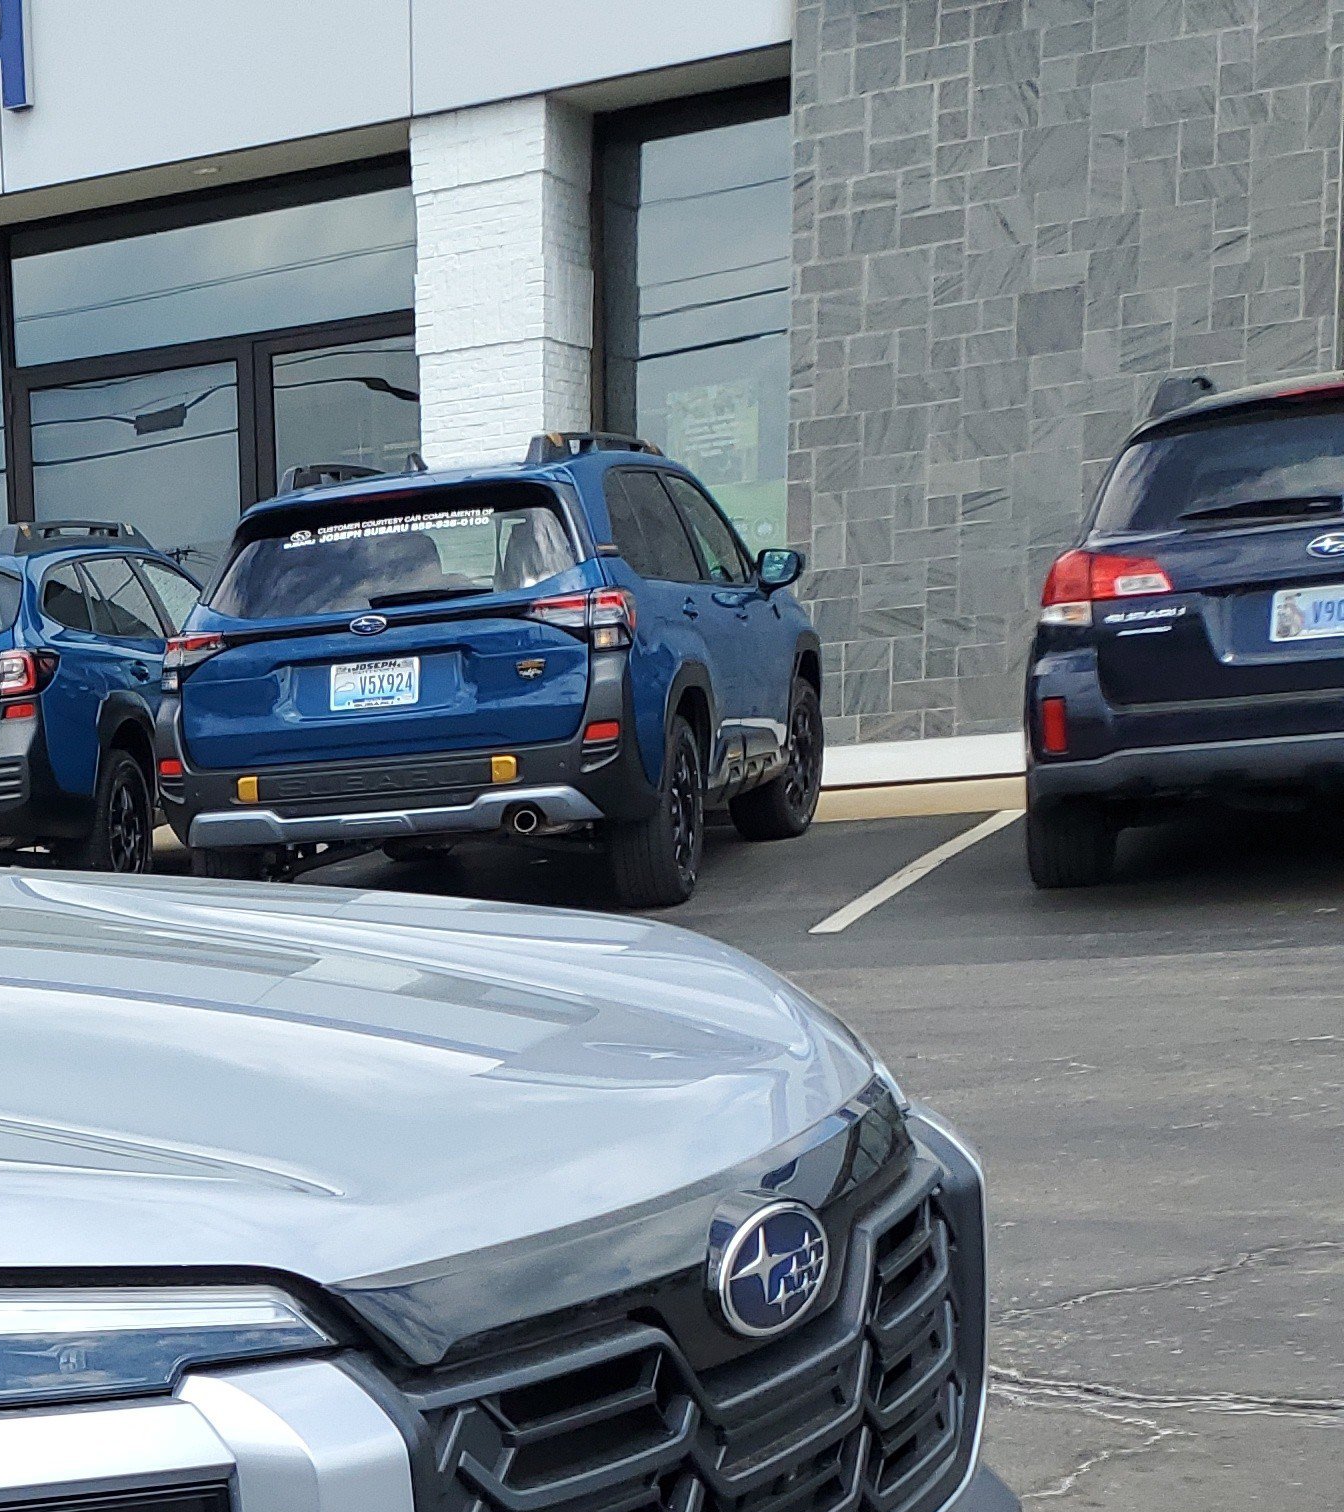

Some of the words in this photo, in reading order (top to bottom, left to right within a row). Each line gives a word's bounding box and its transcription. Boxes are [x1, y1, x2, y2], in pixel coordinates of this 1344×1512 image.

[318, 521, 361, 535] CUSTOMER
[362, 516, 403, 529] COURTESY
[404, 514, 421, 523] CAR
[422, 508, 481, 520] COMPLIMENTS
[319, 529, 362, 543] JOSEPH
[364, 523, 409, 537] SUBARU
[352, 660, 397, 672] JOSEPH
[359, 671, 413, 696] V5X924
